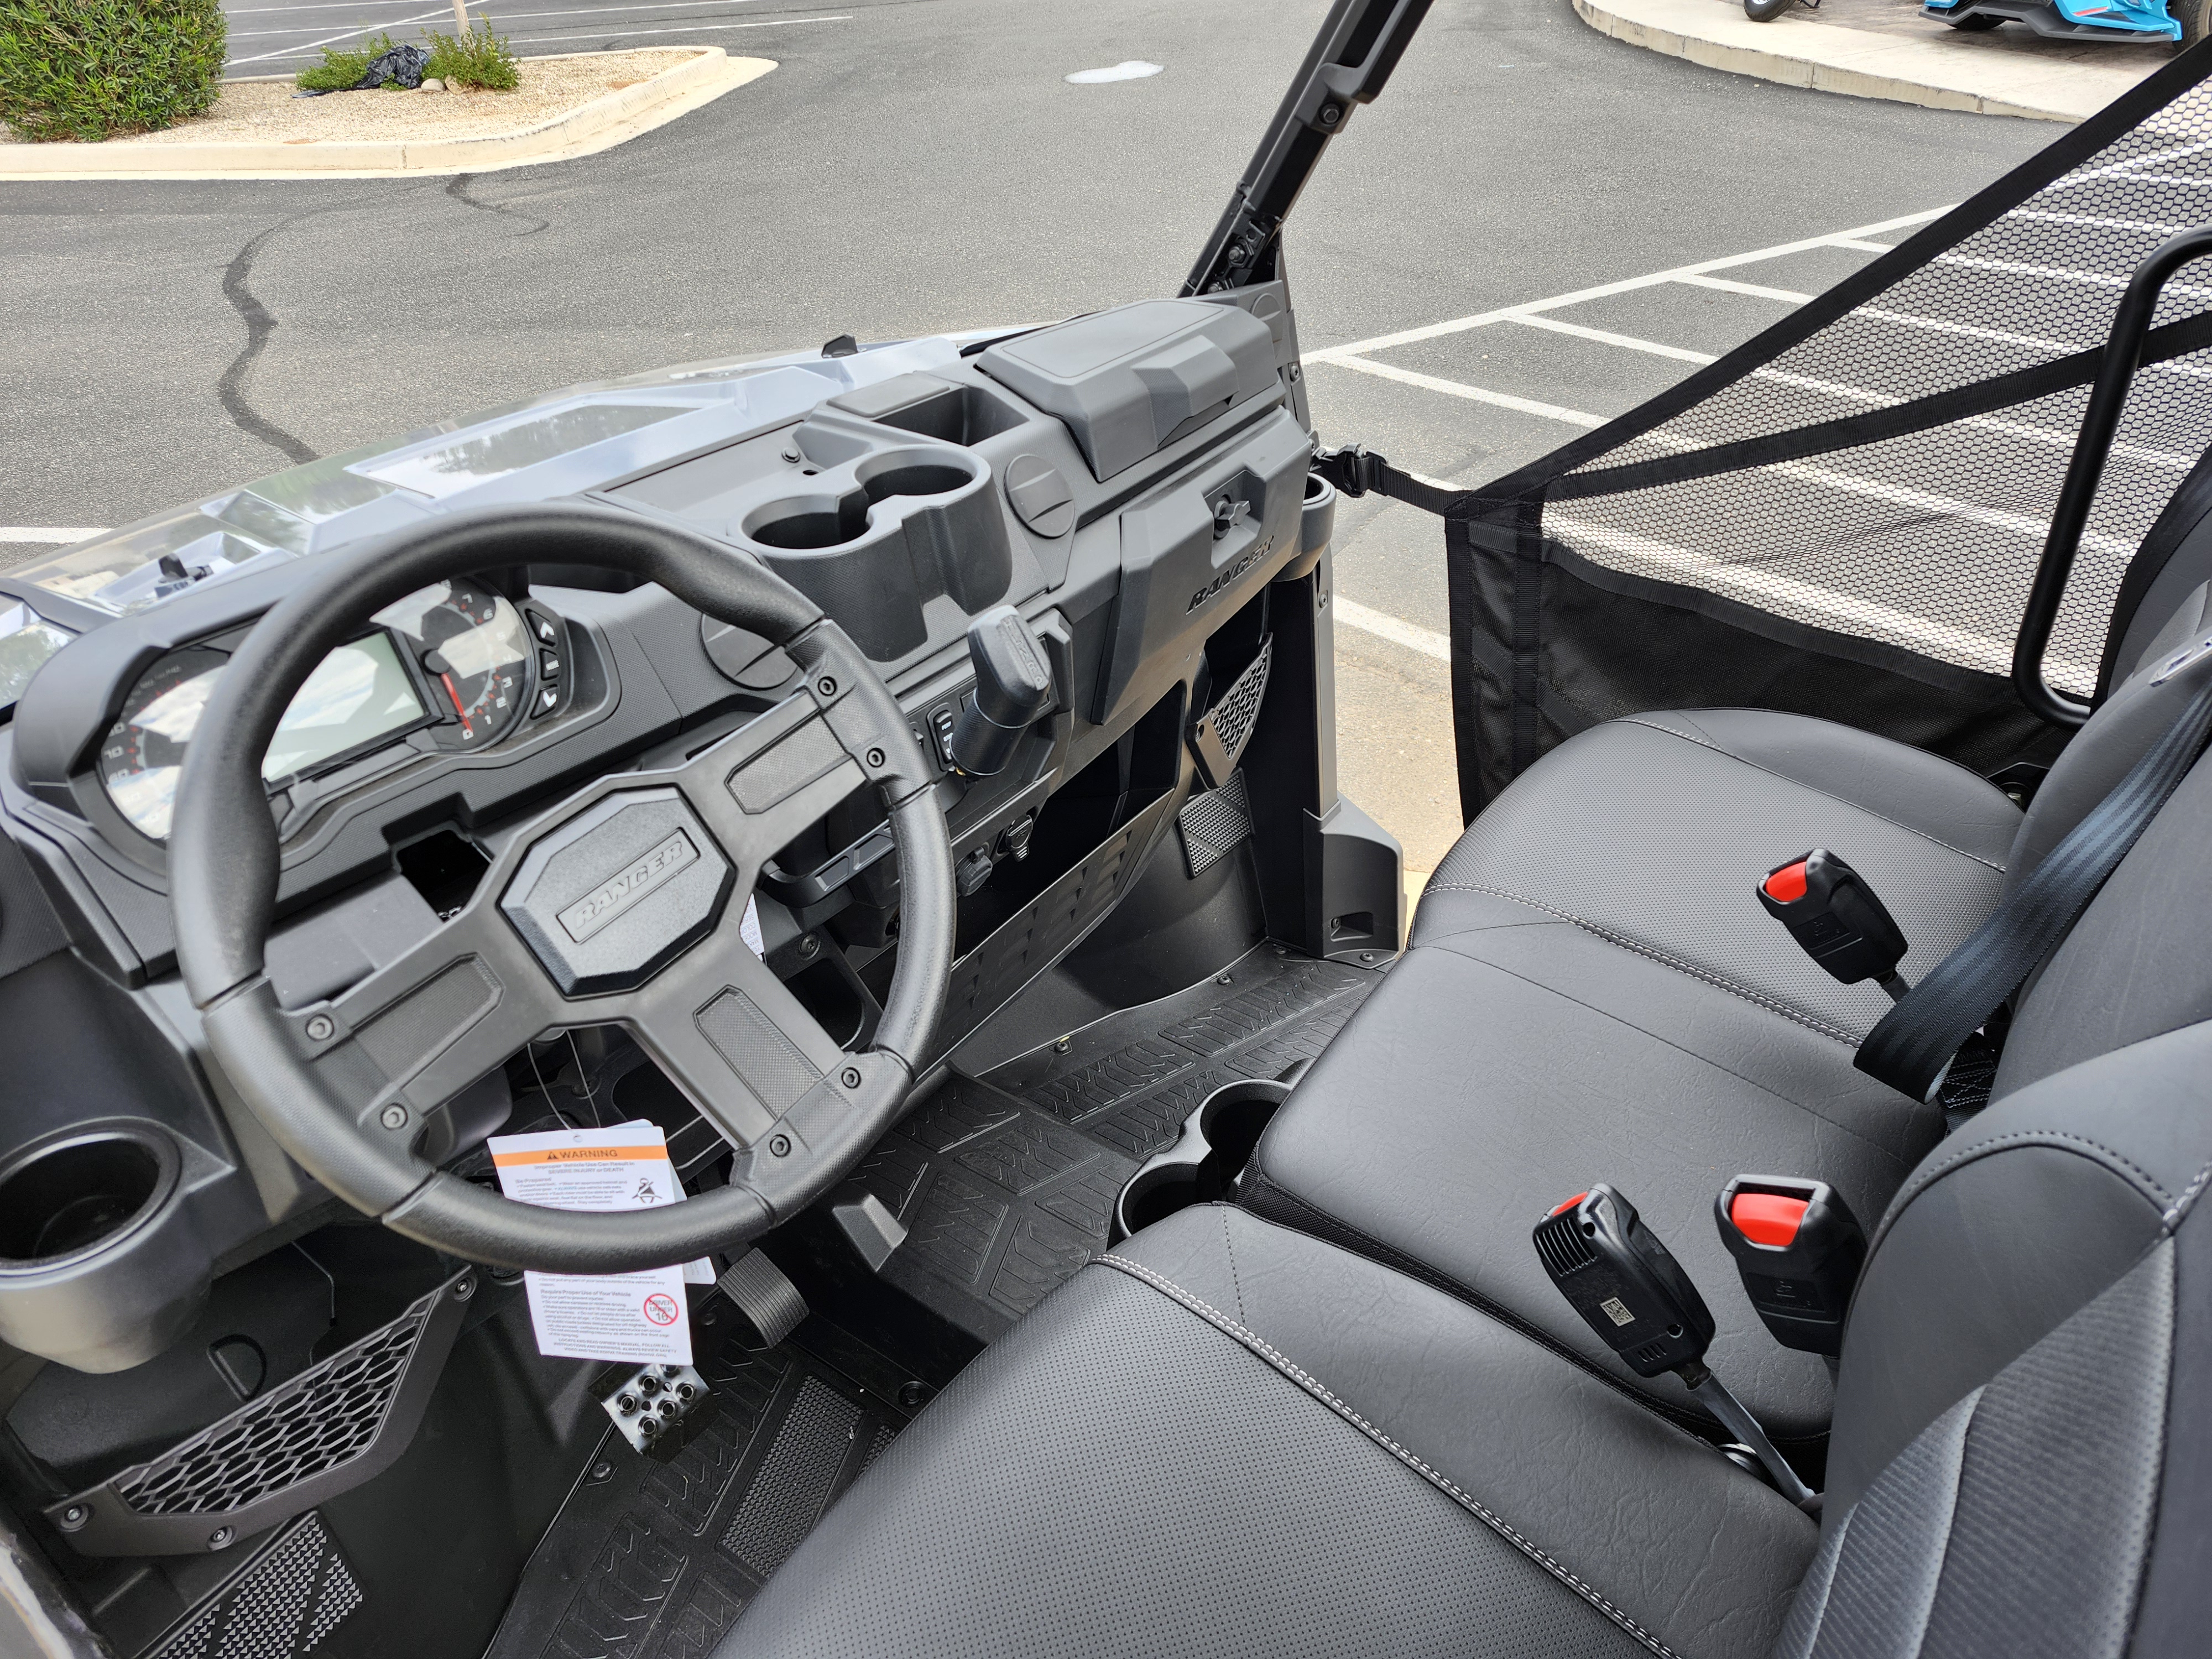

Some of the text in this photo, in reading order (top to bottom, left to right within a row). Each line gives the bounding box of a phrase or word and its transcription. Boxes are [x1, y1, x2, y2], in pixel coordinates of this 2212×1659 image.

[1186, 535, 1274, 615] RANGER
[462, 593, 473, 603] 7
[483, 608, 493, 620] 6
[503, 677, 513, 687] 3
[497, 697, 507, 708] 2
[485, 715, 492, 724] 1
[462, 729, 473, 740] 0
[104, 746, 124, 759] 70
[575, 841, 683, 930] RANGER
[560, 1150, 618, 1159] WARNING
